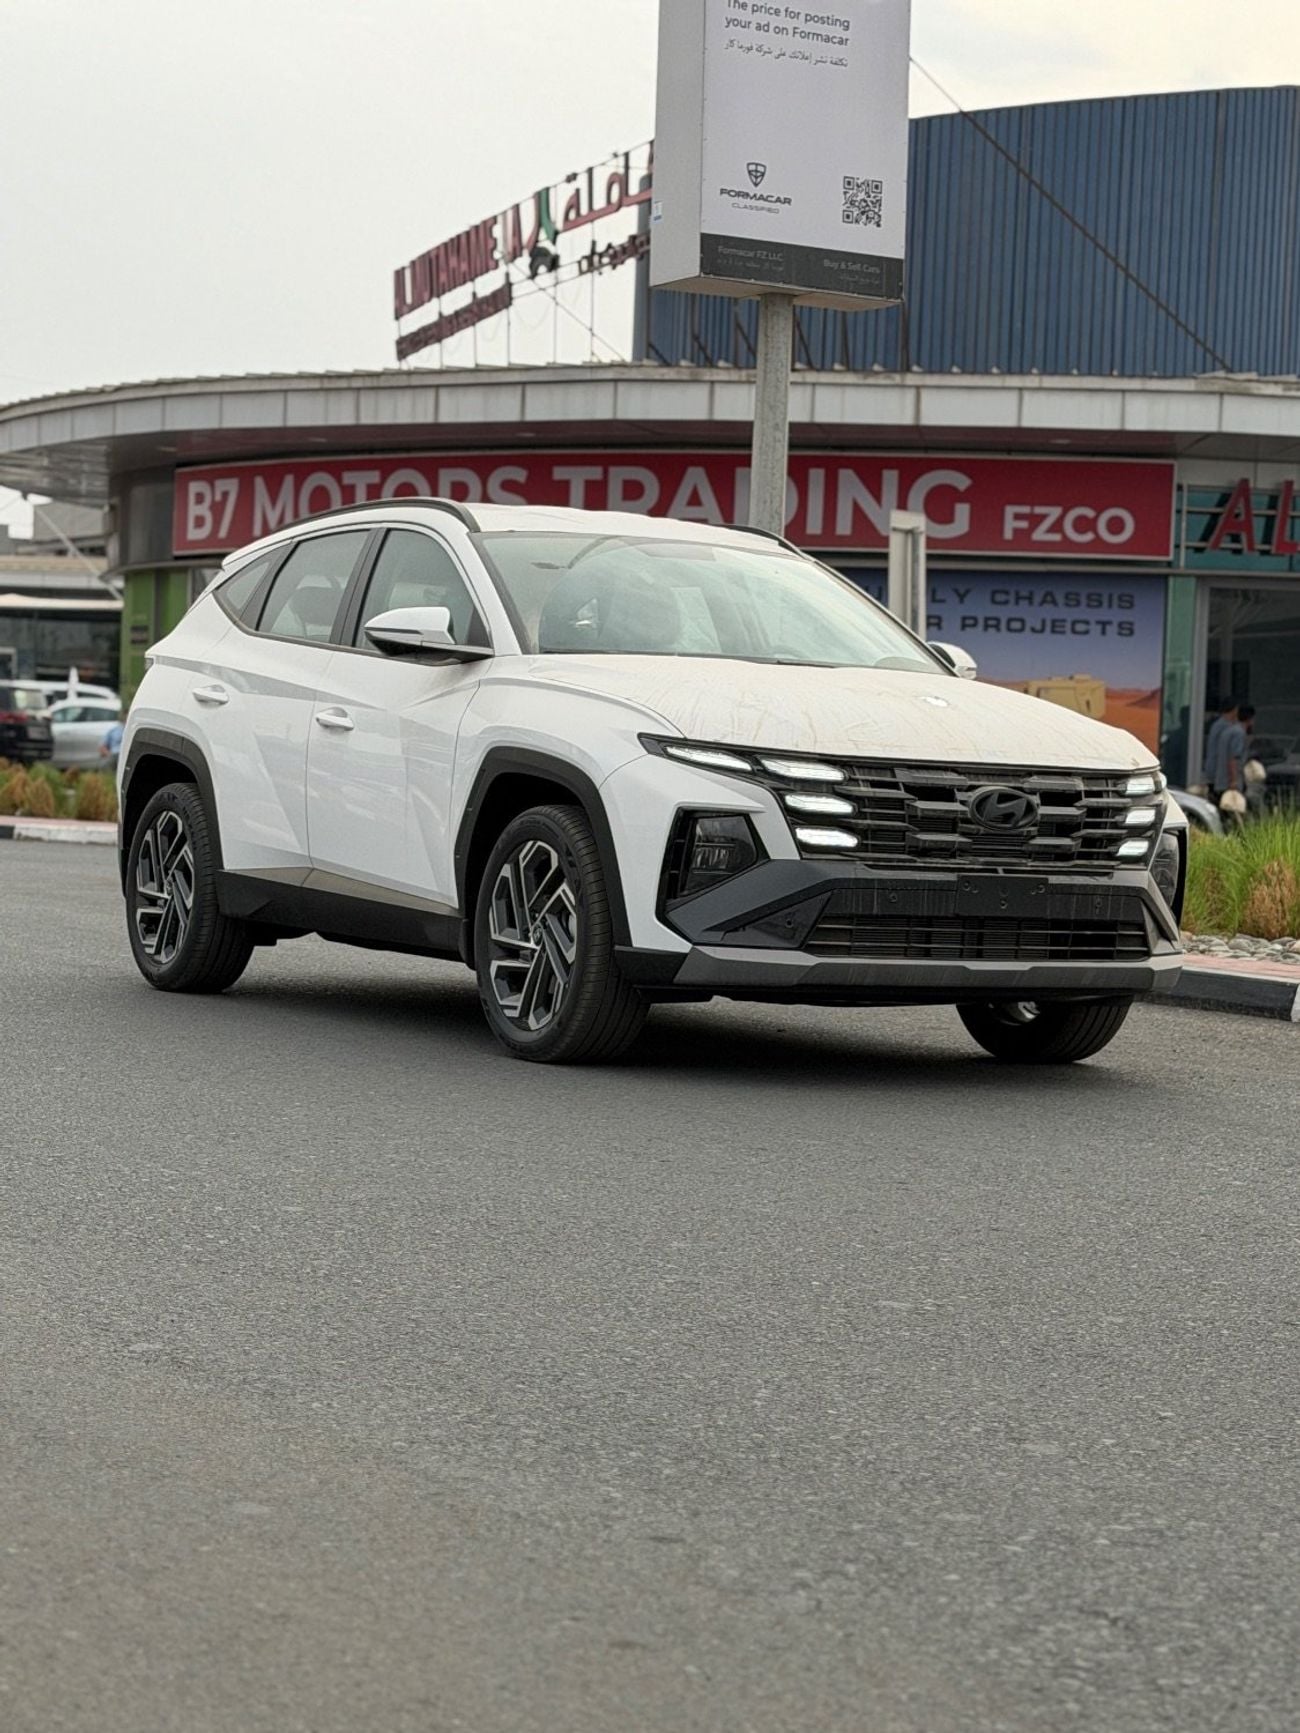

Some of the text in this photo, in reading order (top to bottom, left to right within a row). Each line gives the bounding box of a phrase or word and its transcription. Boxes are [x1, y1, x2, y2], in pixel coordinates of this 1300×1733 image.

[751, 3, 781, 17] price
[784, 6, 801, 20] for
[804, 13, 850, 31] posting
[725, 16, 849, 46] your ad on Formacar
[720, 188, 792, 206] FORMACAR
[186, 477, 240, 541] B7
[1003, 506, 1134, 544] FZCO
[990, 589, 1136, 610] CHASSIS
[960, 615, 1136, 637] PROJECTS
